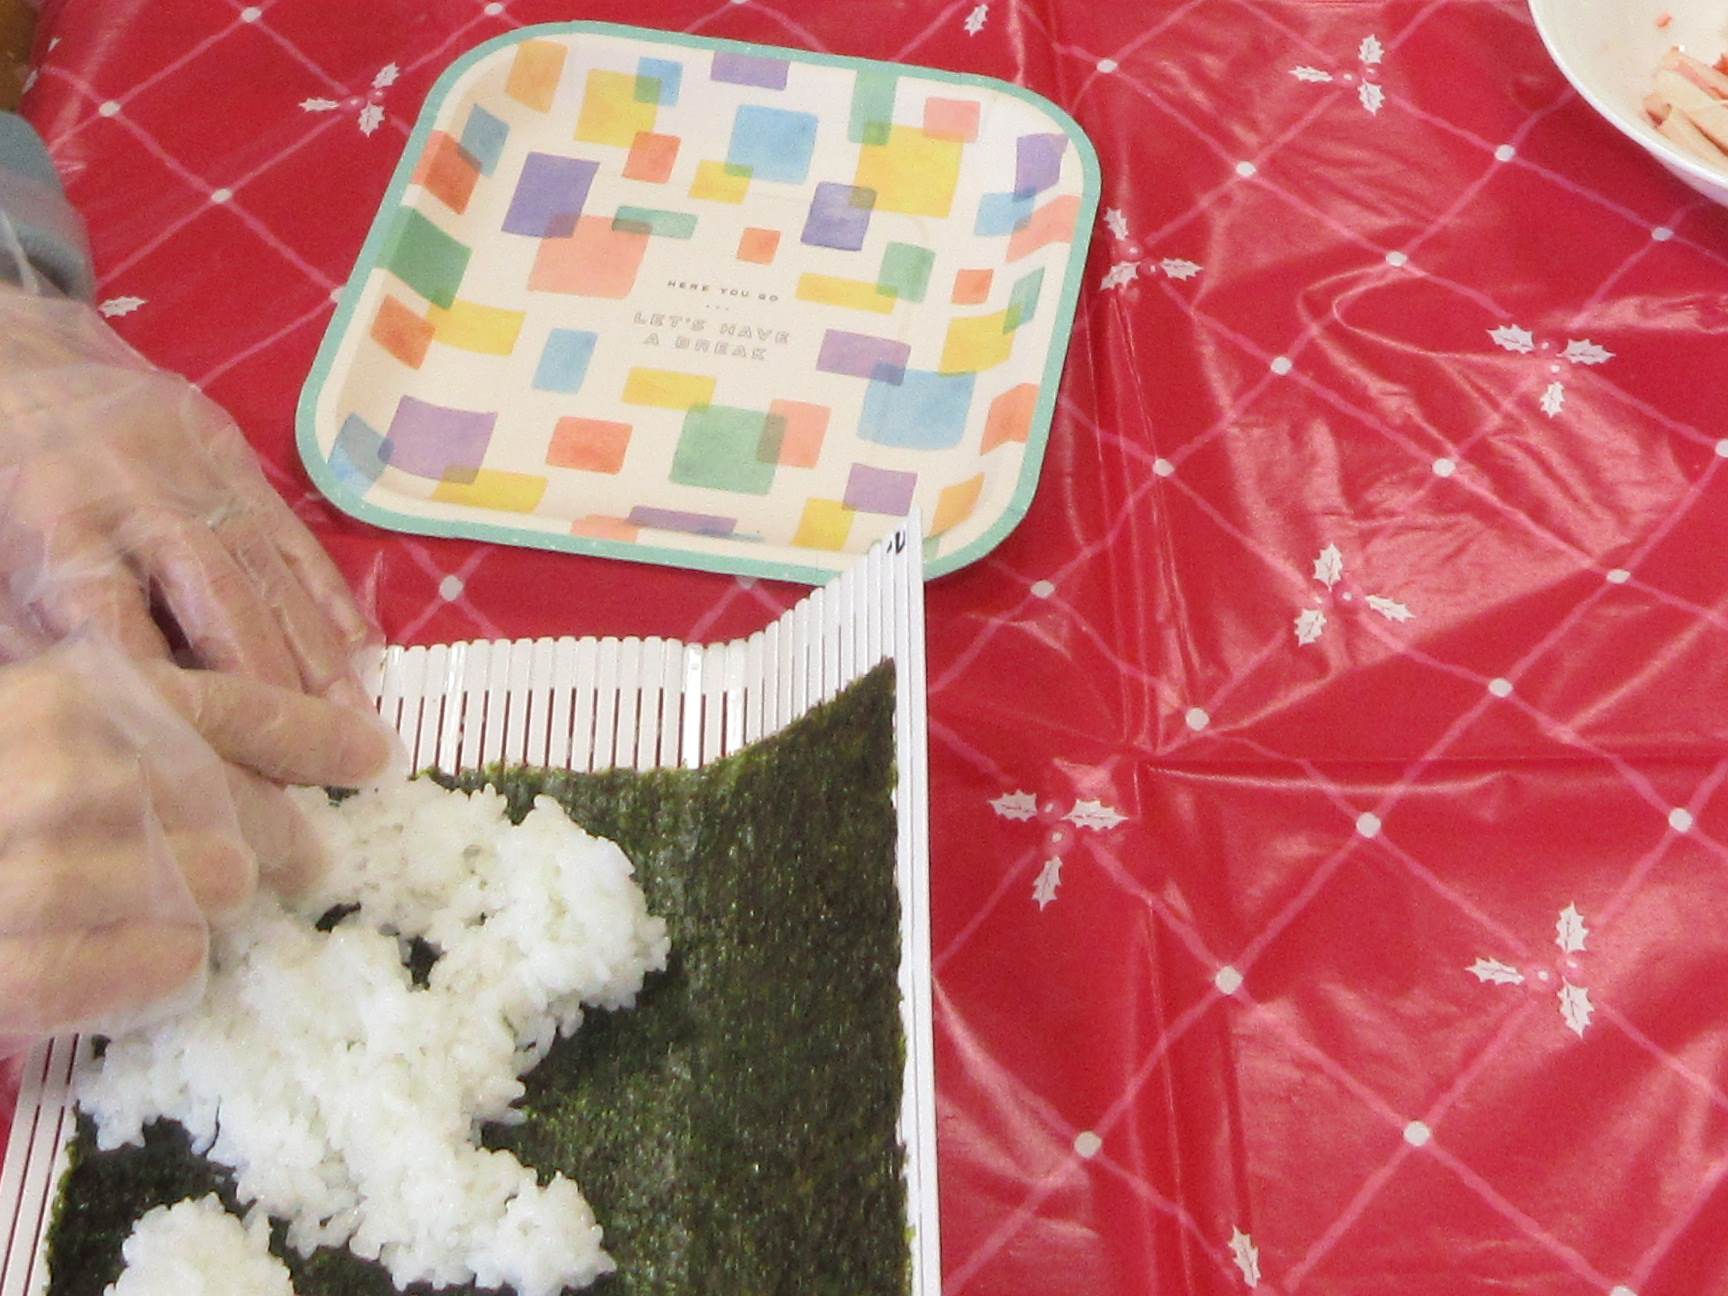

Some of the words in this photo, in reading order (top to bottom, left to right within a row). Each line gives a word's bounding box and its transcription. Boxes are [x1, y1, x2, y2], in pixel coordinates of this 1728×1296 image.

[667, 280, 710, 292] HERE
[720, 287, 750, 298] YOU
[633, 312, 707, 332] LET'S
[719, 322, 791, 345] HAVE
[643, 332, 661, 346] A
[674, 335, 768, 360] BREAK
